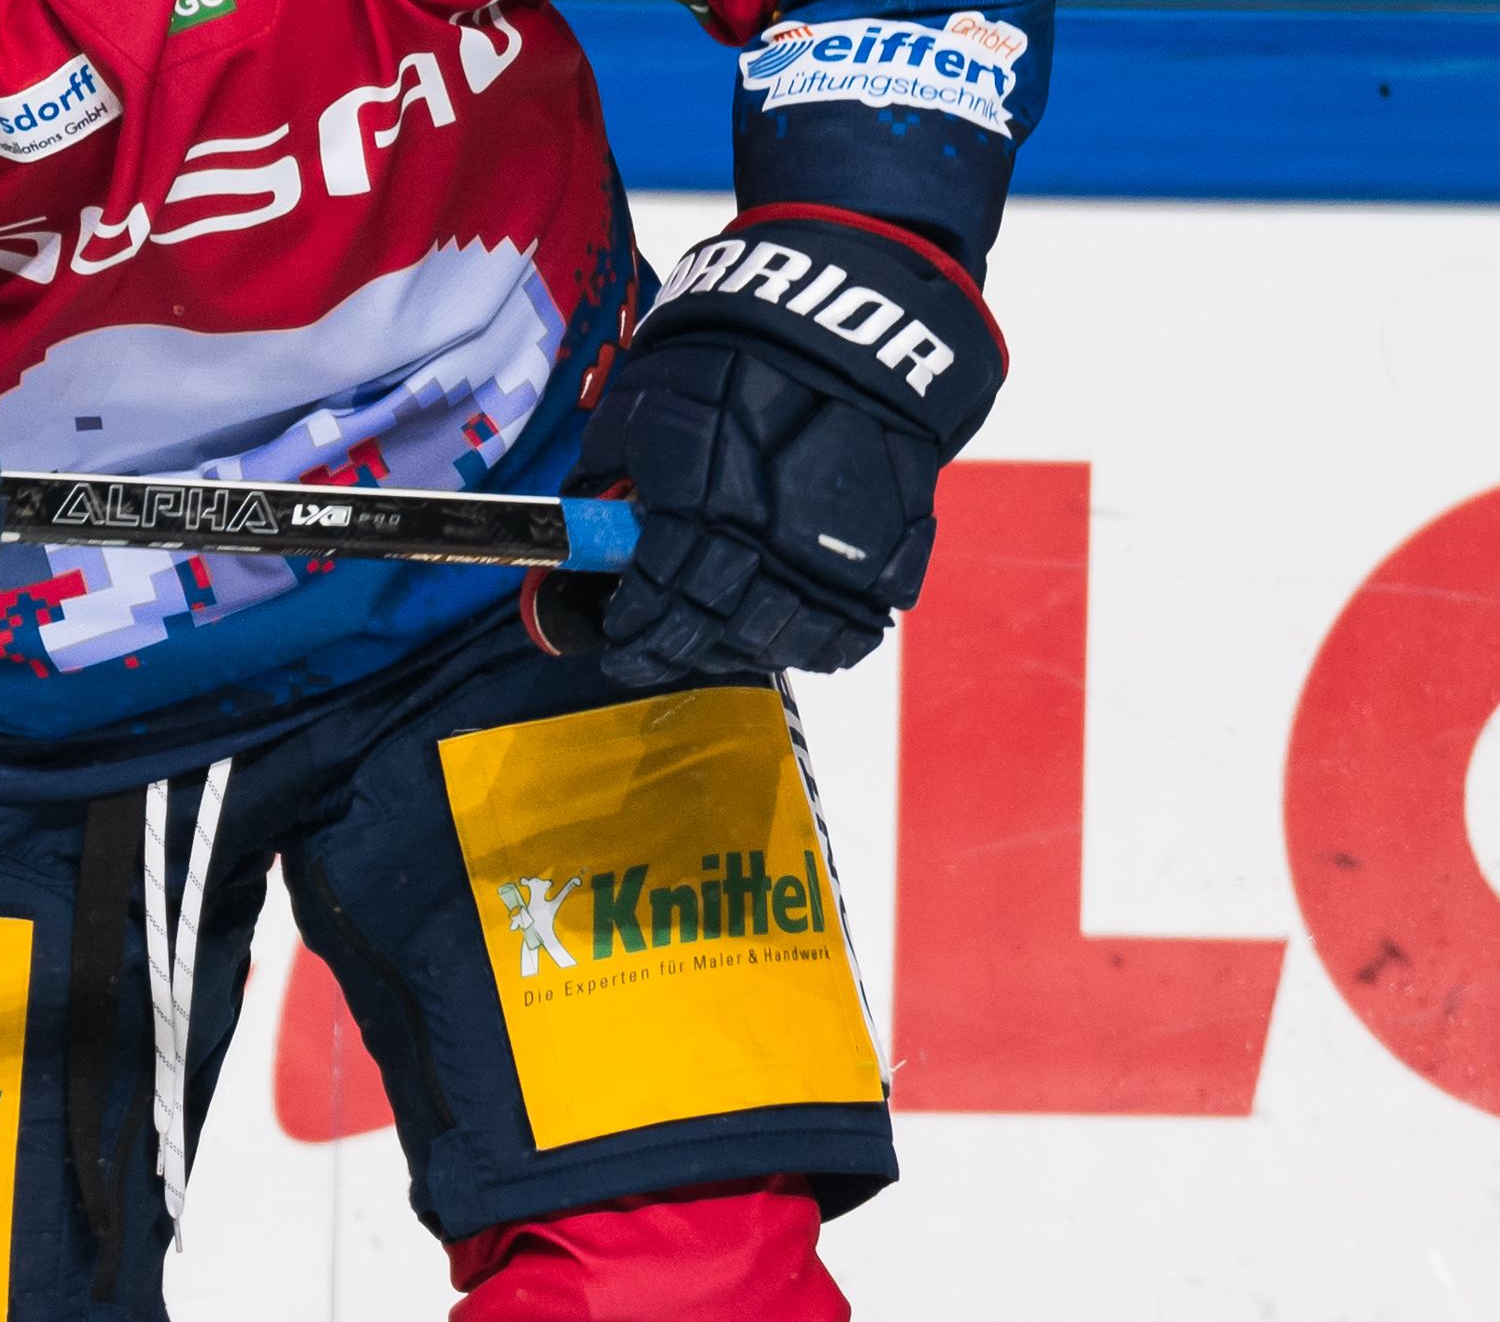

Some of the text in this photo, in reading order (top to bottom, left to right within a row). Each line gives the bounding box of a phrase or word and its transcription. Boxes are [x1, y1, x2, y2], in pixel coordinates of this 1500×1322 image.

[950, 17, 1022, 59] GmbH
[64, 102, 109, 136] GmbH
[771, 70, 1001, 126] Lüftungstechnik
[632, 239, 956, 398] ARRIOR
[51, 482, 280, 535] ALPHA
[590, 849, 825, 961] Knittel
[524, 945, 831, 1007] Die Experten für Maler & Handwerk
